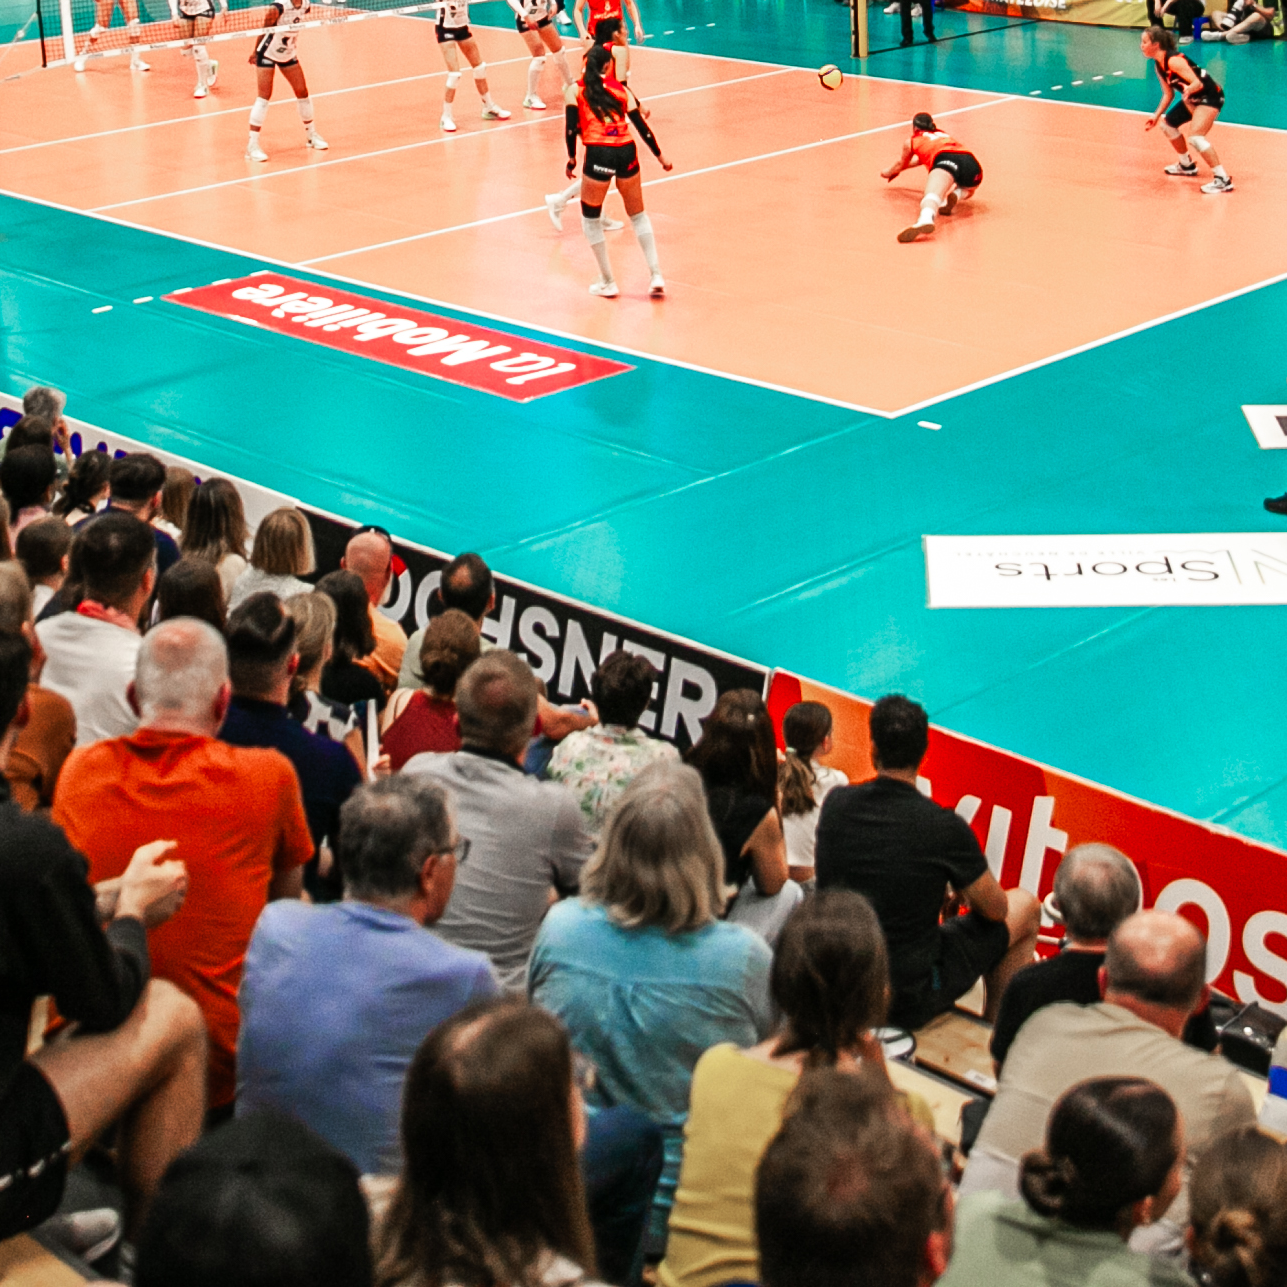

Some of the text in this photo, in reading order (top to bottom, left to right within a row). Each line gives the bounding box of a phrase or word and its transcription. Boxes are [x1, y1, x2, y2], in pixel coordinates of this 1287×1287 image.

[231, 283, 577, 385] la Mobilière
[994, 556, 1220, 583] Sports
